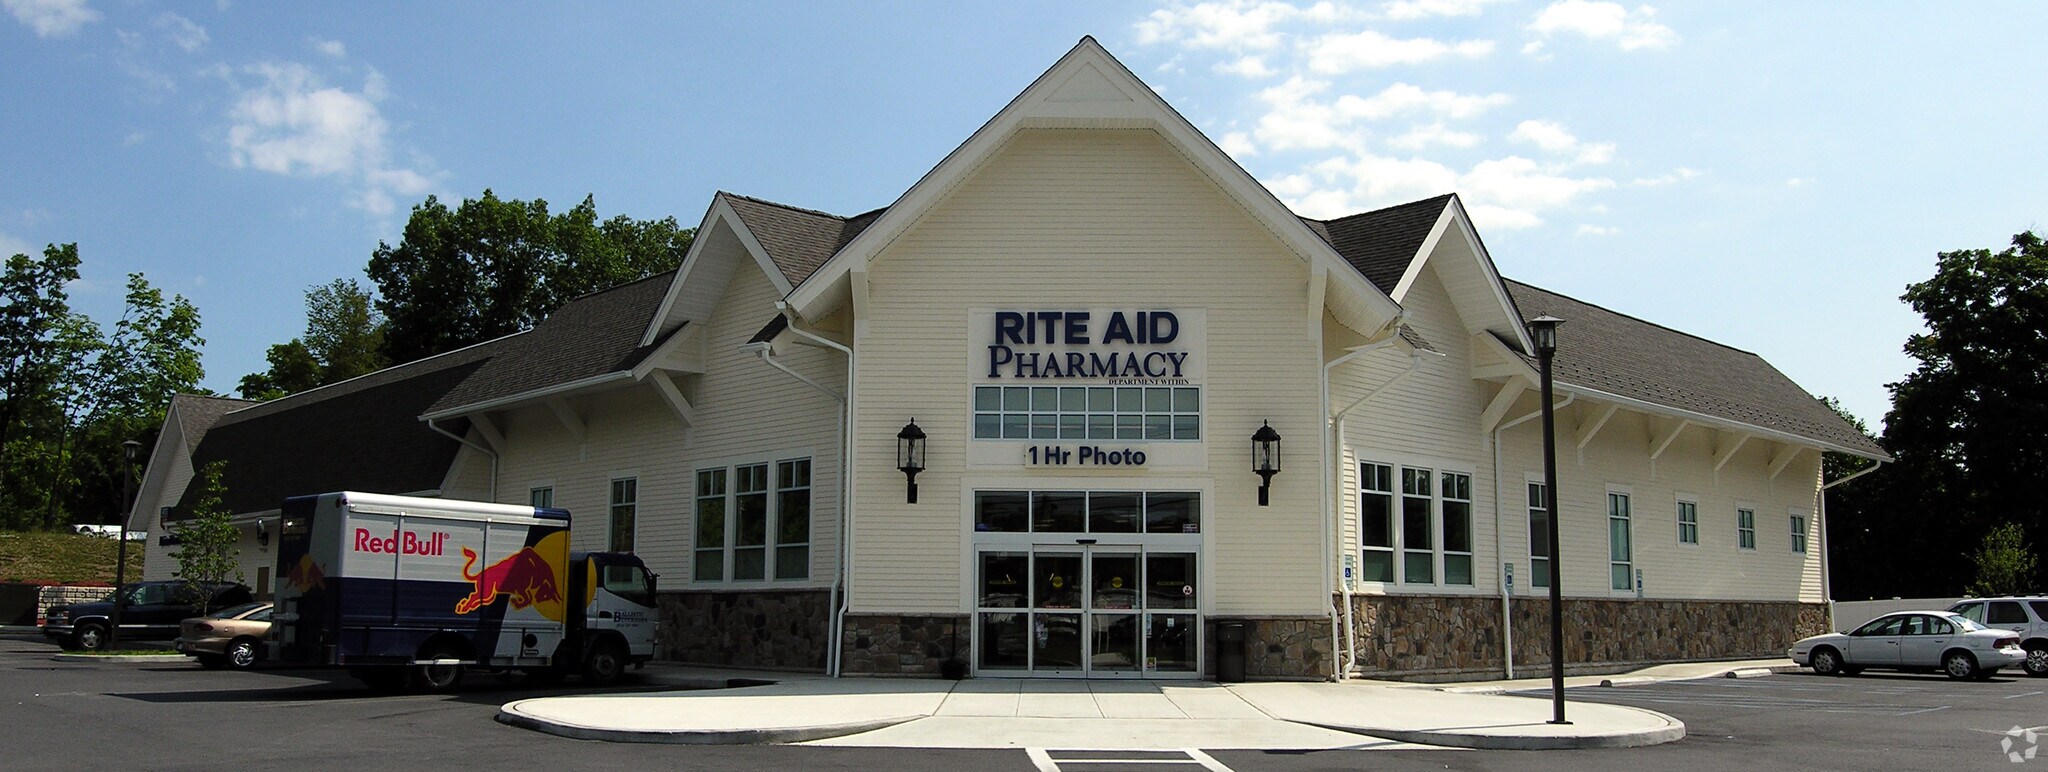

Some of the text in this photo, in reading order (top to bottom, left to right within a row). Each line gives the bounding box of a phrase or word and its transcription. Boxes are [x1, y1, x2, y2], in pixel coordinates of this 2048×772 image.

[995, 311, 1180, 345] RITE AID
[987, 345, 1189, 378] PHARMACY
[1028, 446, 1147, 466] 1 Hr Photo
[354, 527, 400, 554] Red
